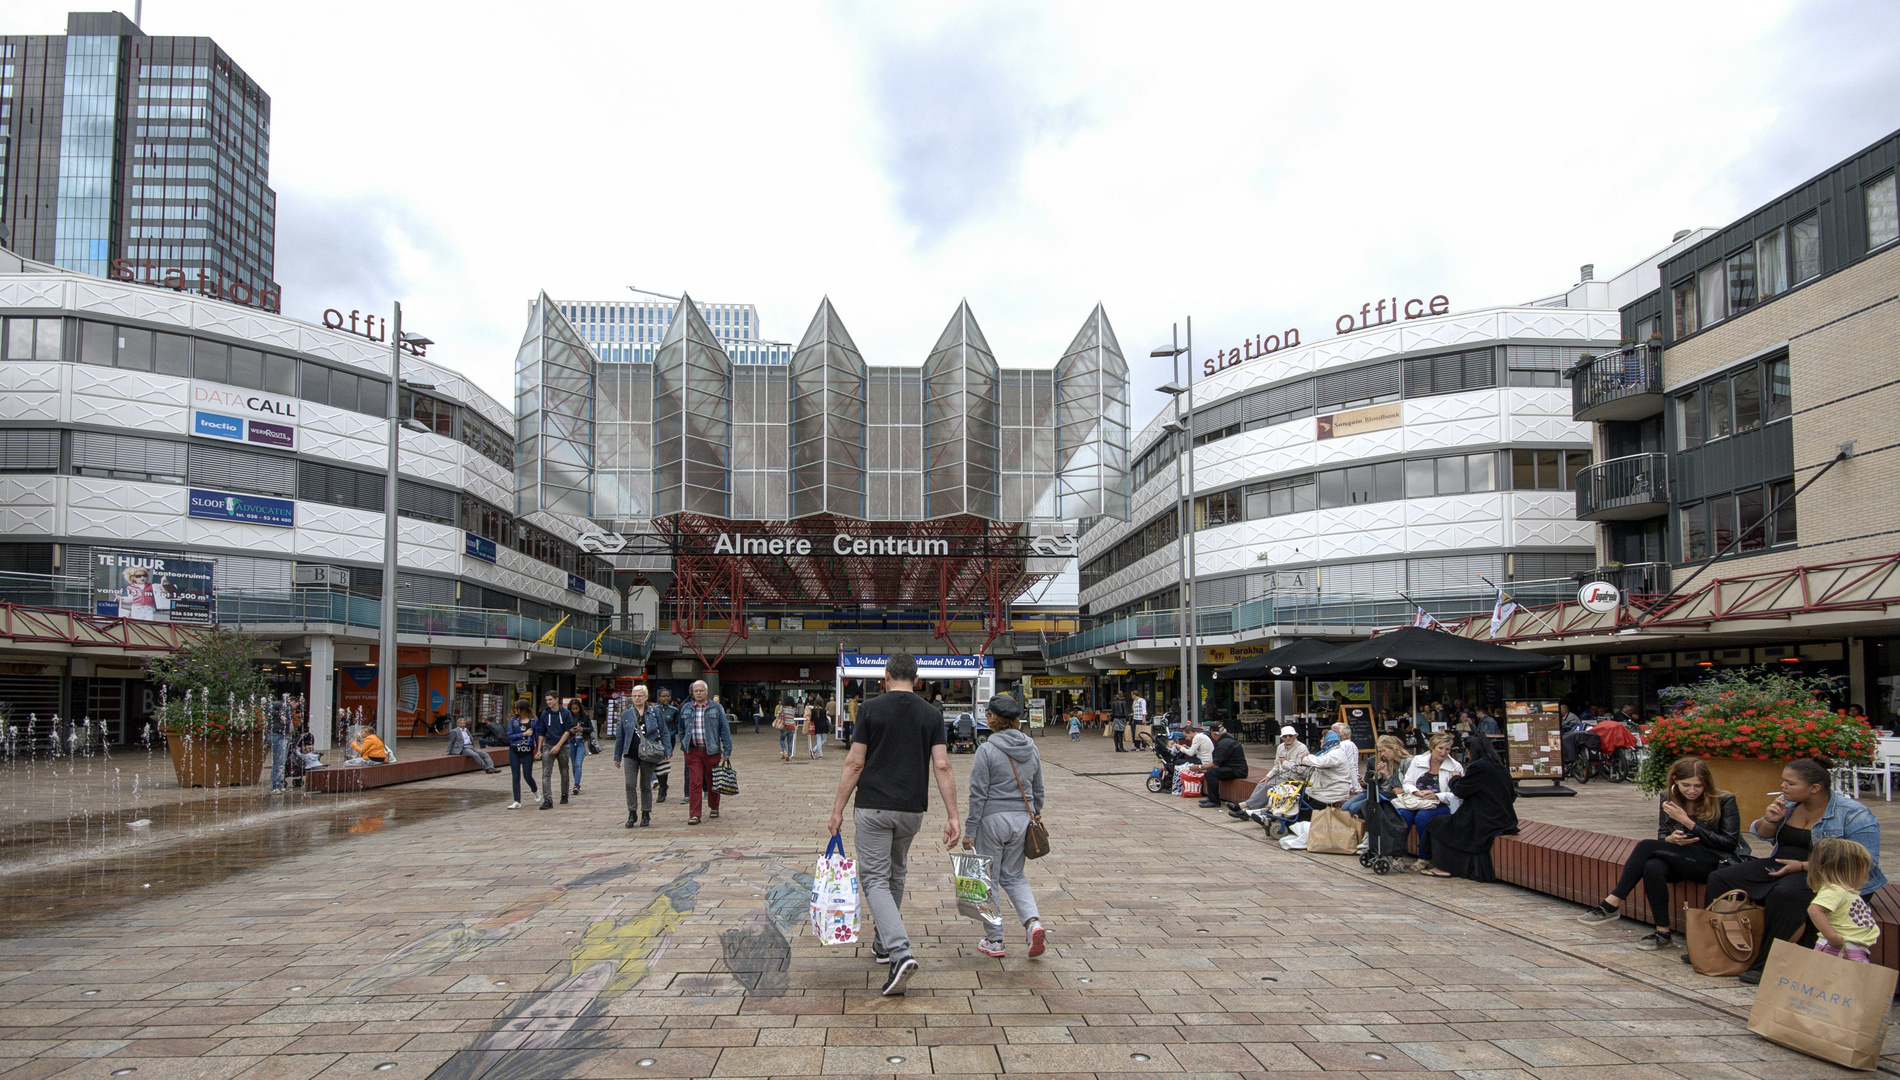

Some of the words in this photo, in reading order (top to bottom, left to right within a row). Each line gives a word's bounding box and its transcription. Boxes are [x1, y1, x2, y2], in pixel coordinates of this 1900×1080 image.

[111, 258, 280, 311] station
[1203, 328, 1299, 376] station
[1336, 294, 1449, 334] office
[1364, 412, 1400, 423] Bloedbank
[191, 497, 225, 509] SLOOF
[235, 504, 292, 517] ADVOCATEN
[713, 533, 812, 555] Almere
[833, 533, 949, 556] Centrum
[97, 554, 115, 566] TE
[118, 555, 165, 570] HUUR
[152, 569, 211, 580] kantoorruimte
[314, 567, 325, 581] B
[340, 571, 347, 584] B
[1293, 574, 1303, 587] A
[1270, 575, 1276, 588] A
[97, 587, 124, 595] vanaf
[1230, 646, 1263, 655] Barakha
[856, 656, 887, 665] Volenda
[914, 658, 945, 666] shandel
[945, 658, 963, 666] Nico
[963, 658, 975, 666] Tol
[1034, 678, 1053, 686] FEBO
